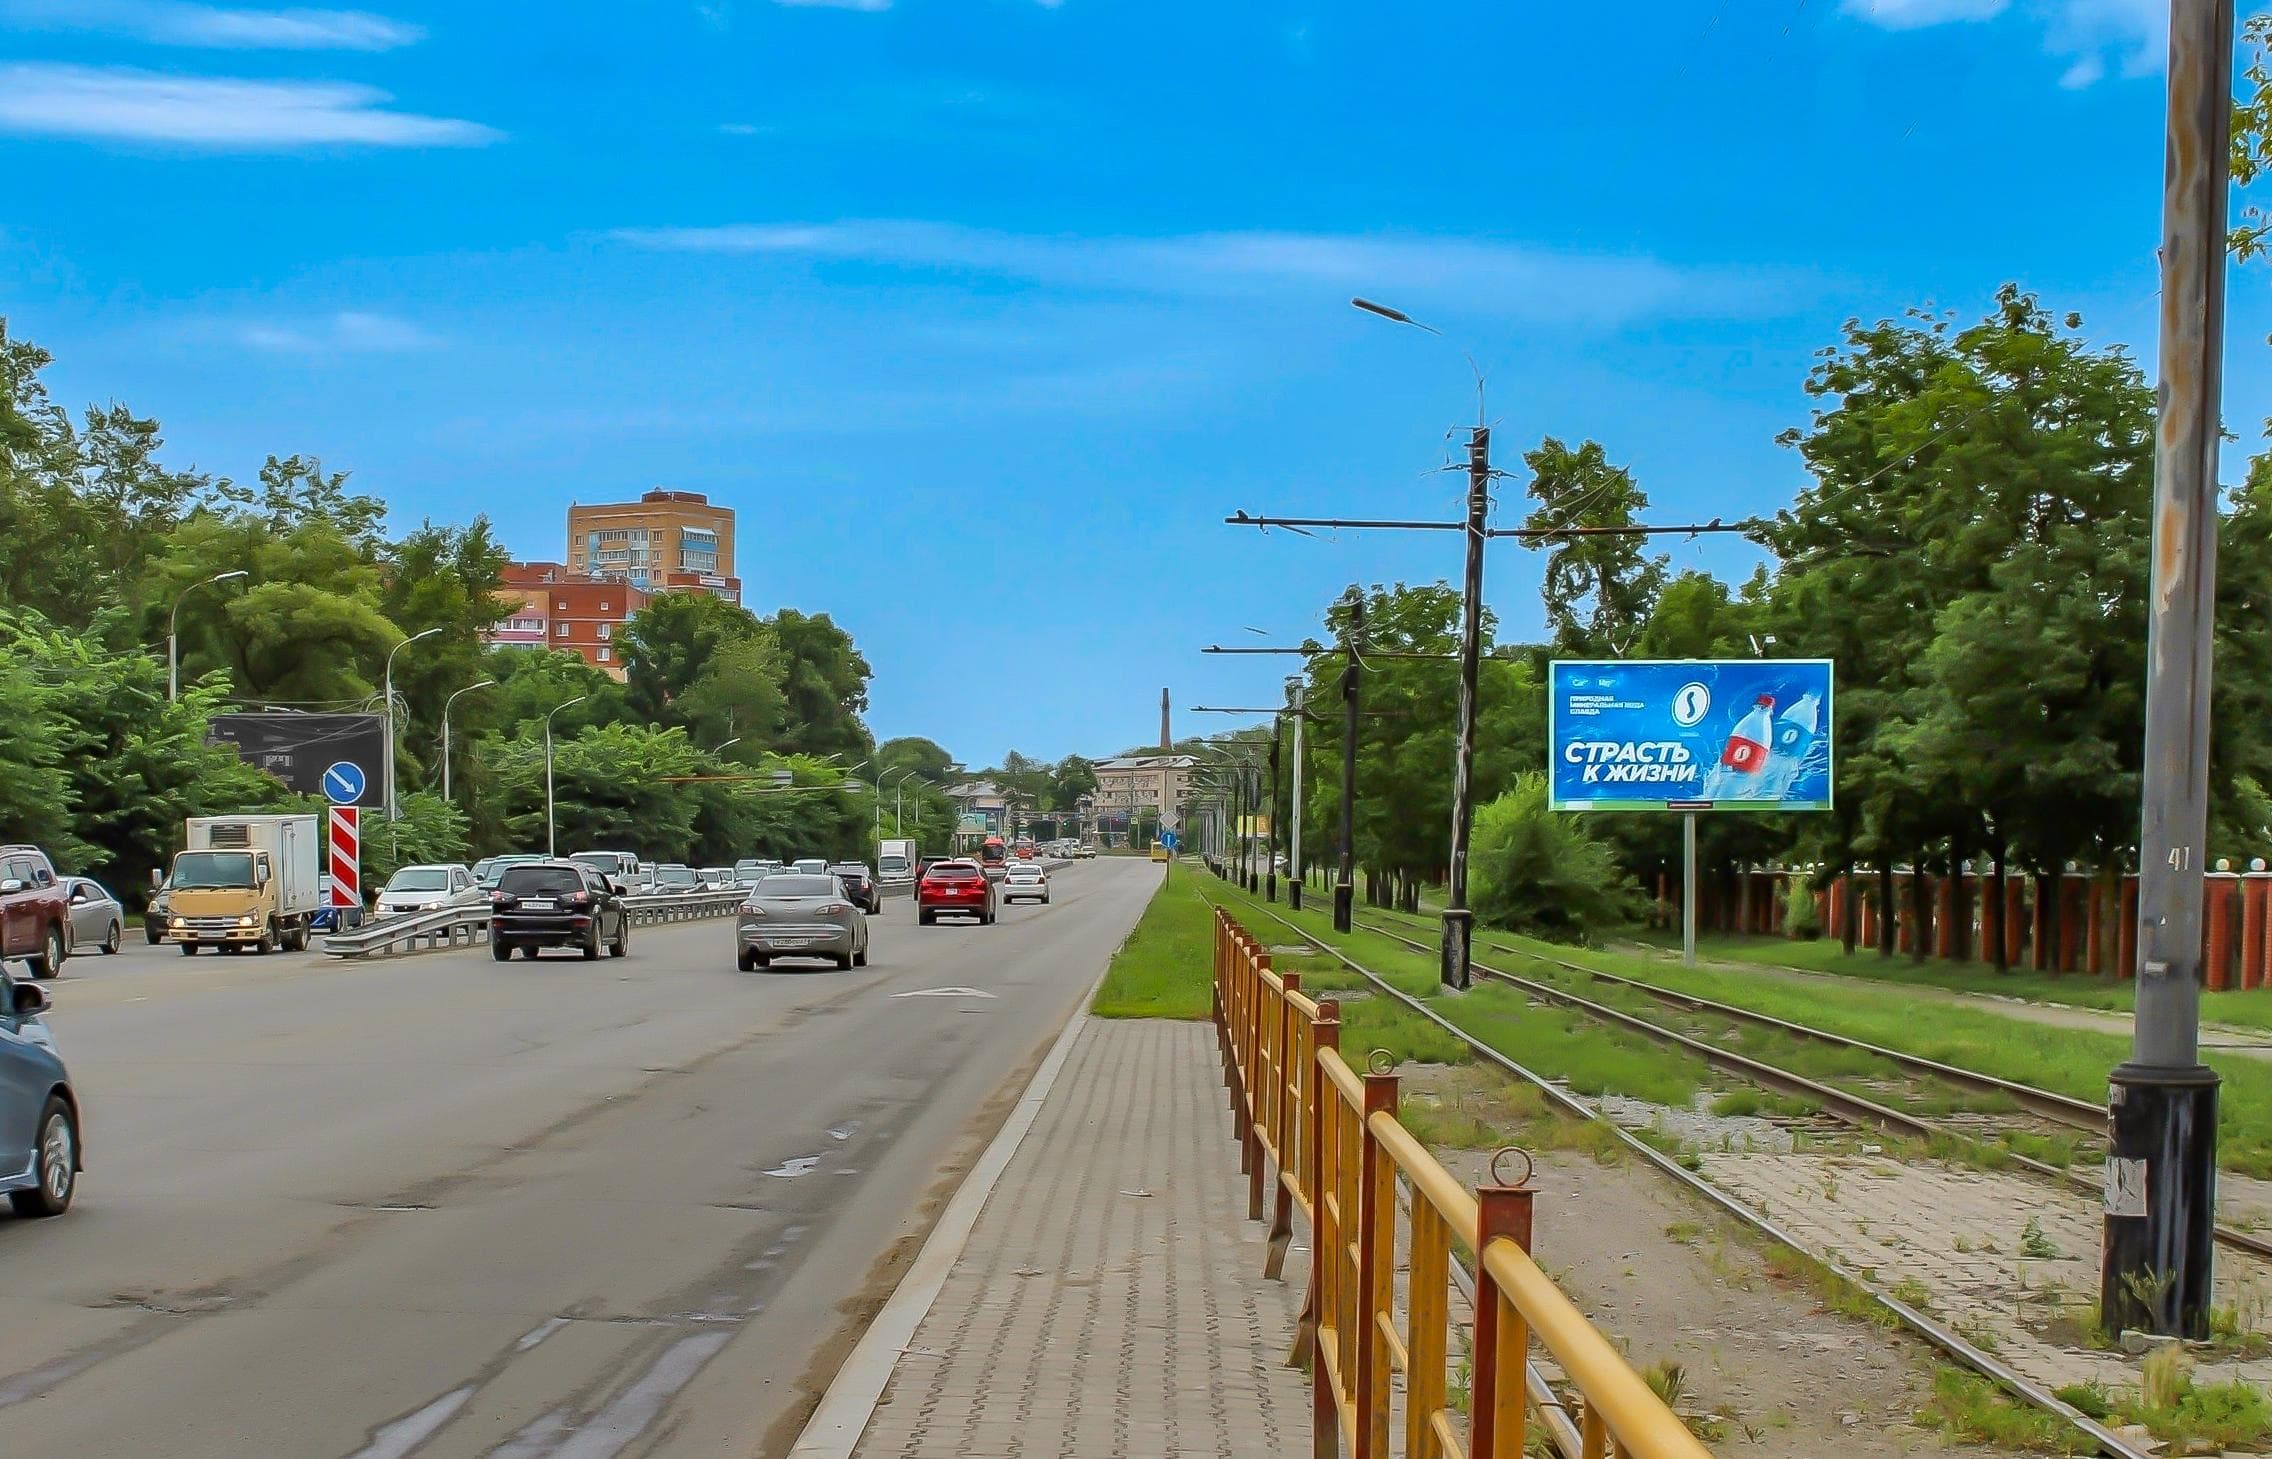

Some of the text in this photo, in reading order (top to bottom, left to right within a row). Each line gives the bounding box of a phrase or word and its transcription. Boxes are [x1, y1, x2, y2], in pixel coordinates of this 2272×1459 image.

[1565, 741, 1690, 763] СТРАСТЬ
[1582, 764, 1697, 782] К ЖИЗНИ
[2168, 846, 2190, 871] 41
